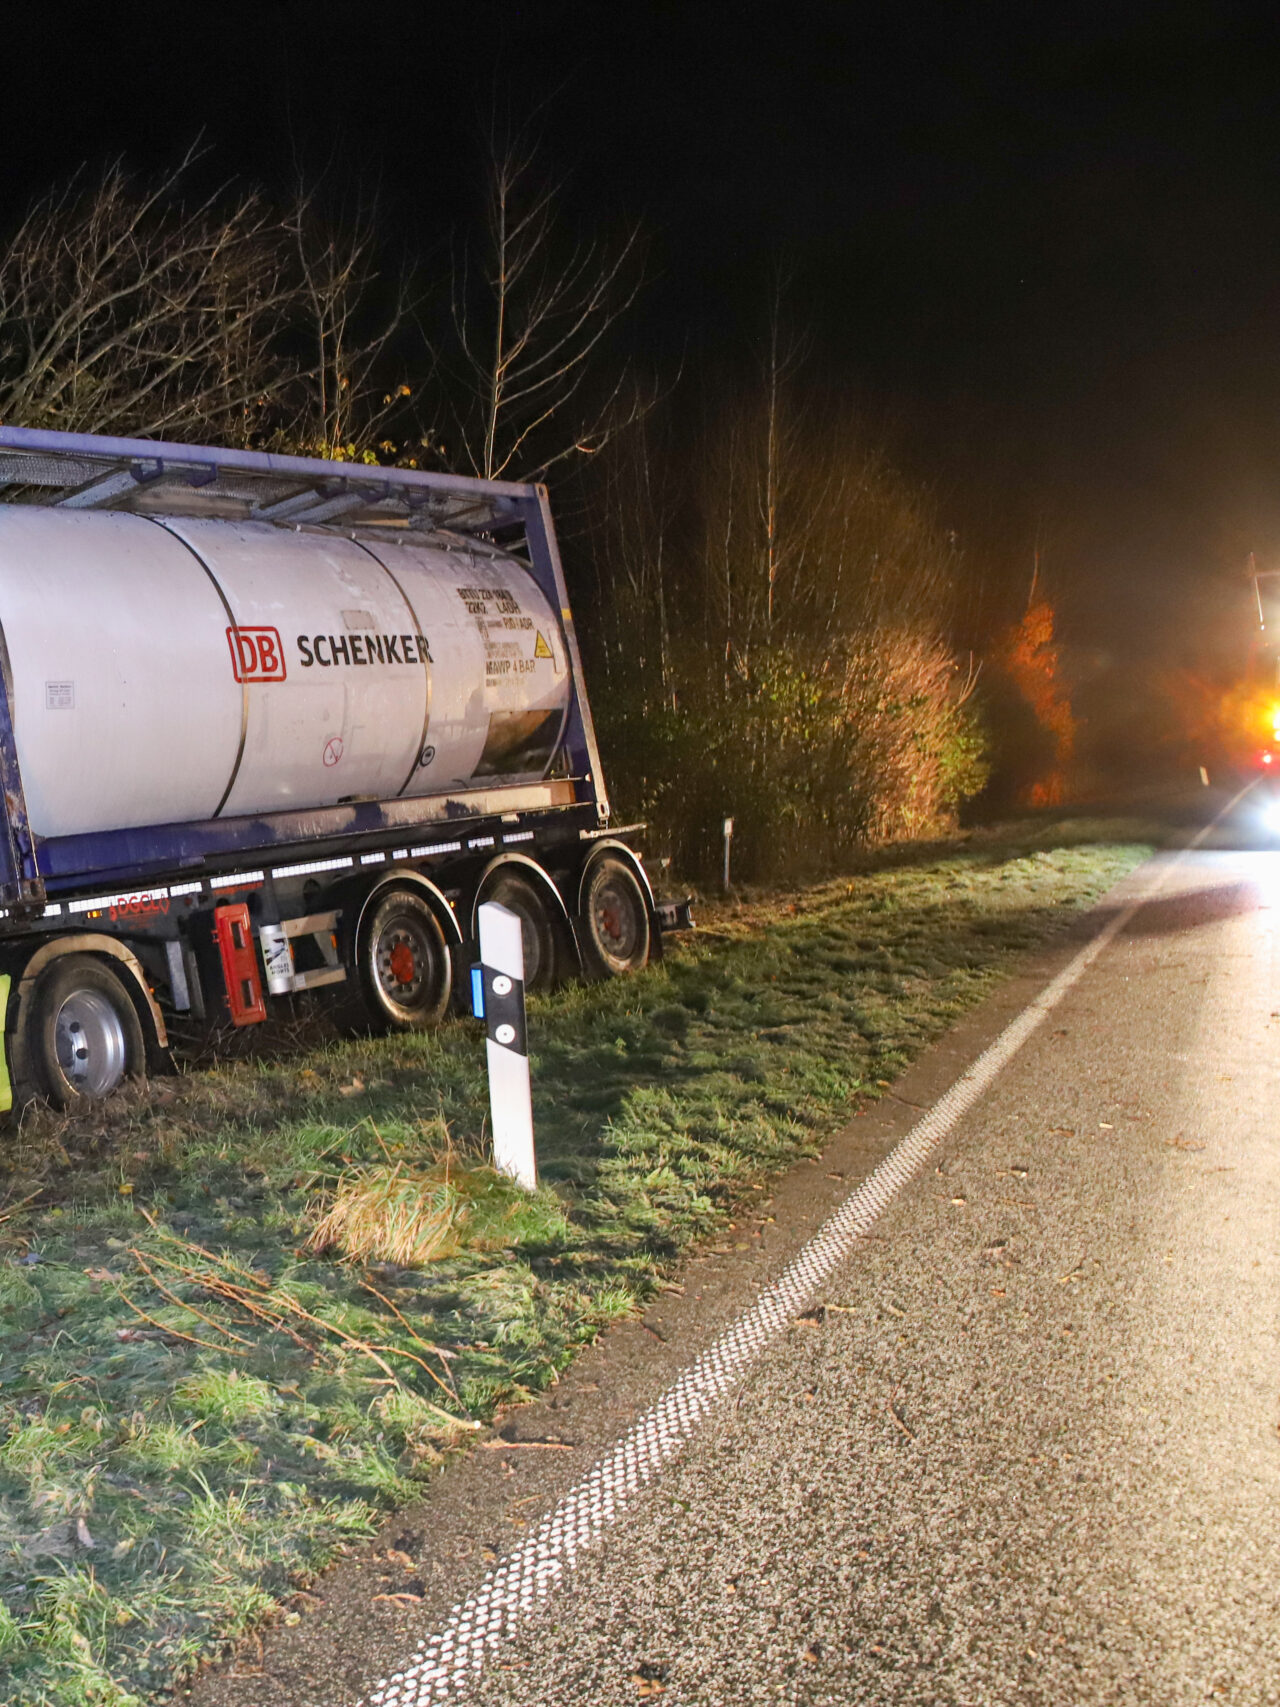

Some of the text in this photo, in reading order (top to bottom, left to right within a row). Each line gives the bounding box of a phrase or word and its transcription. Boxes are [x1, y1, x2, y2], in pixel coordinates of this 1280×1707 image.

[236, 635, 279, 673] DB
[297, 635, 434, 667] SCHENKER
[513, 660, 518, 673] 4
[519, 659, 536, 673] BAR
[118, 894, 160, 915] DGCL
